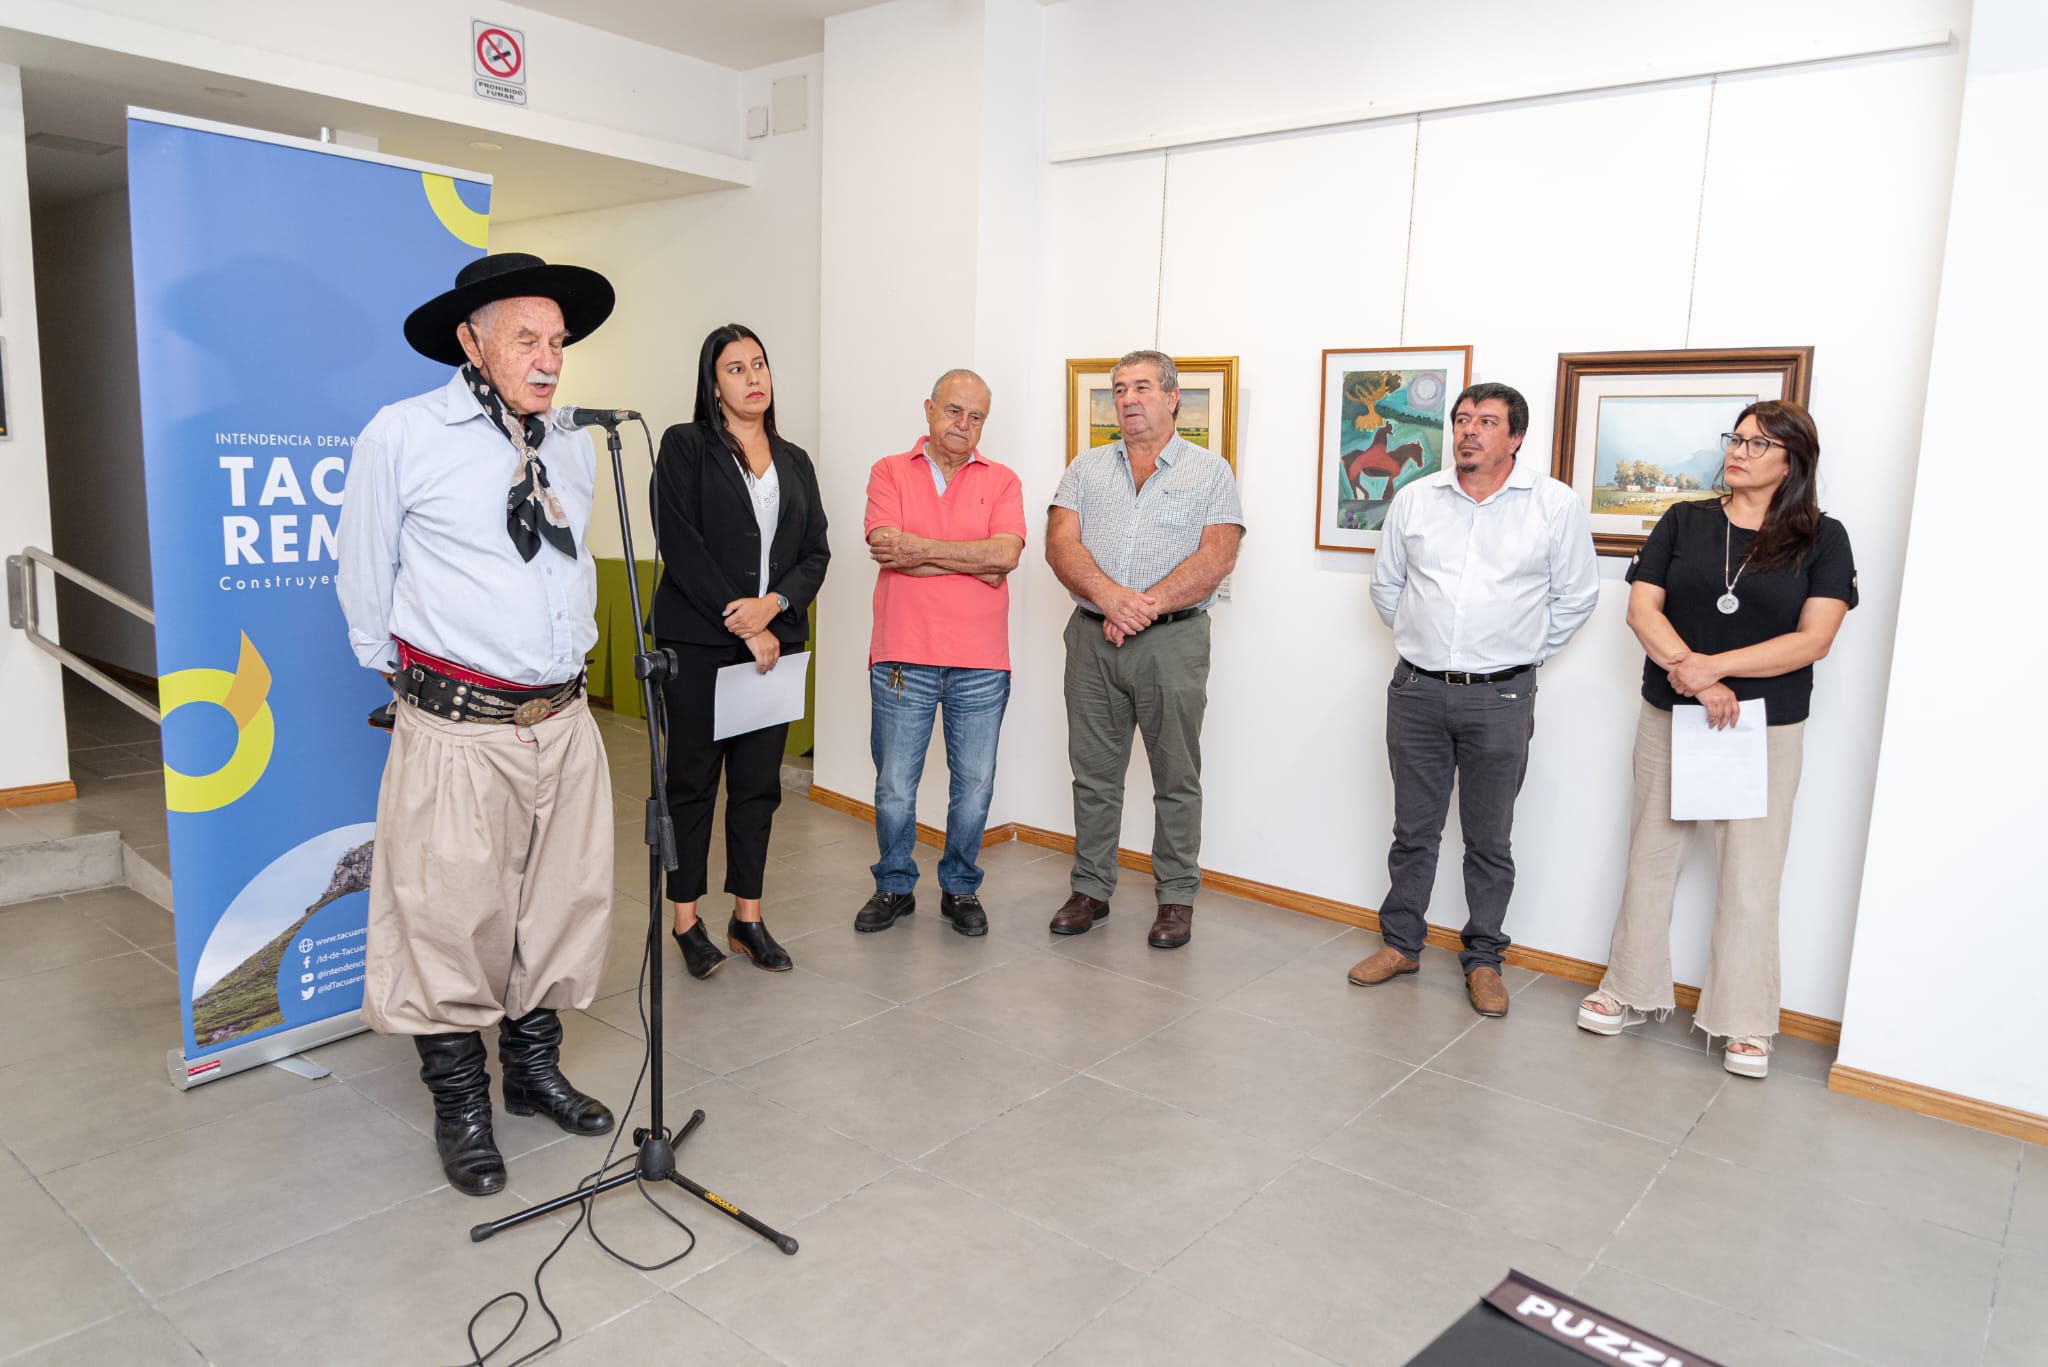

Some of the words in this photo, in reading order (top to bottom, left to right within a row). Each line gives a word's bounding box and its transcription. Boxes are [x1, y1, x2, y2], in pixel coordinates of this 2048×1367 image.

[478, 81, 523, 96] PROHIBIDO
[486, 89, 515, 100] FUMAR
[215, 432, 312, 447] INTENDENCIA
[219, 456, 345, 506] TAC
